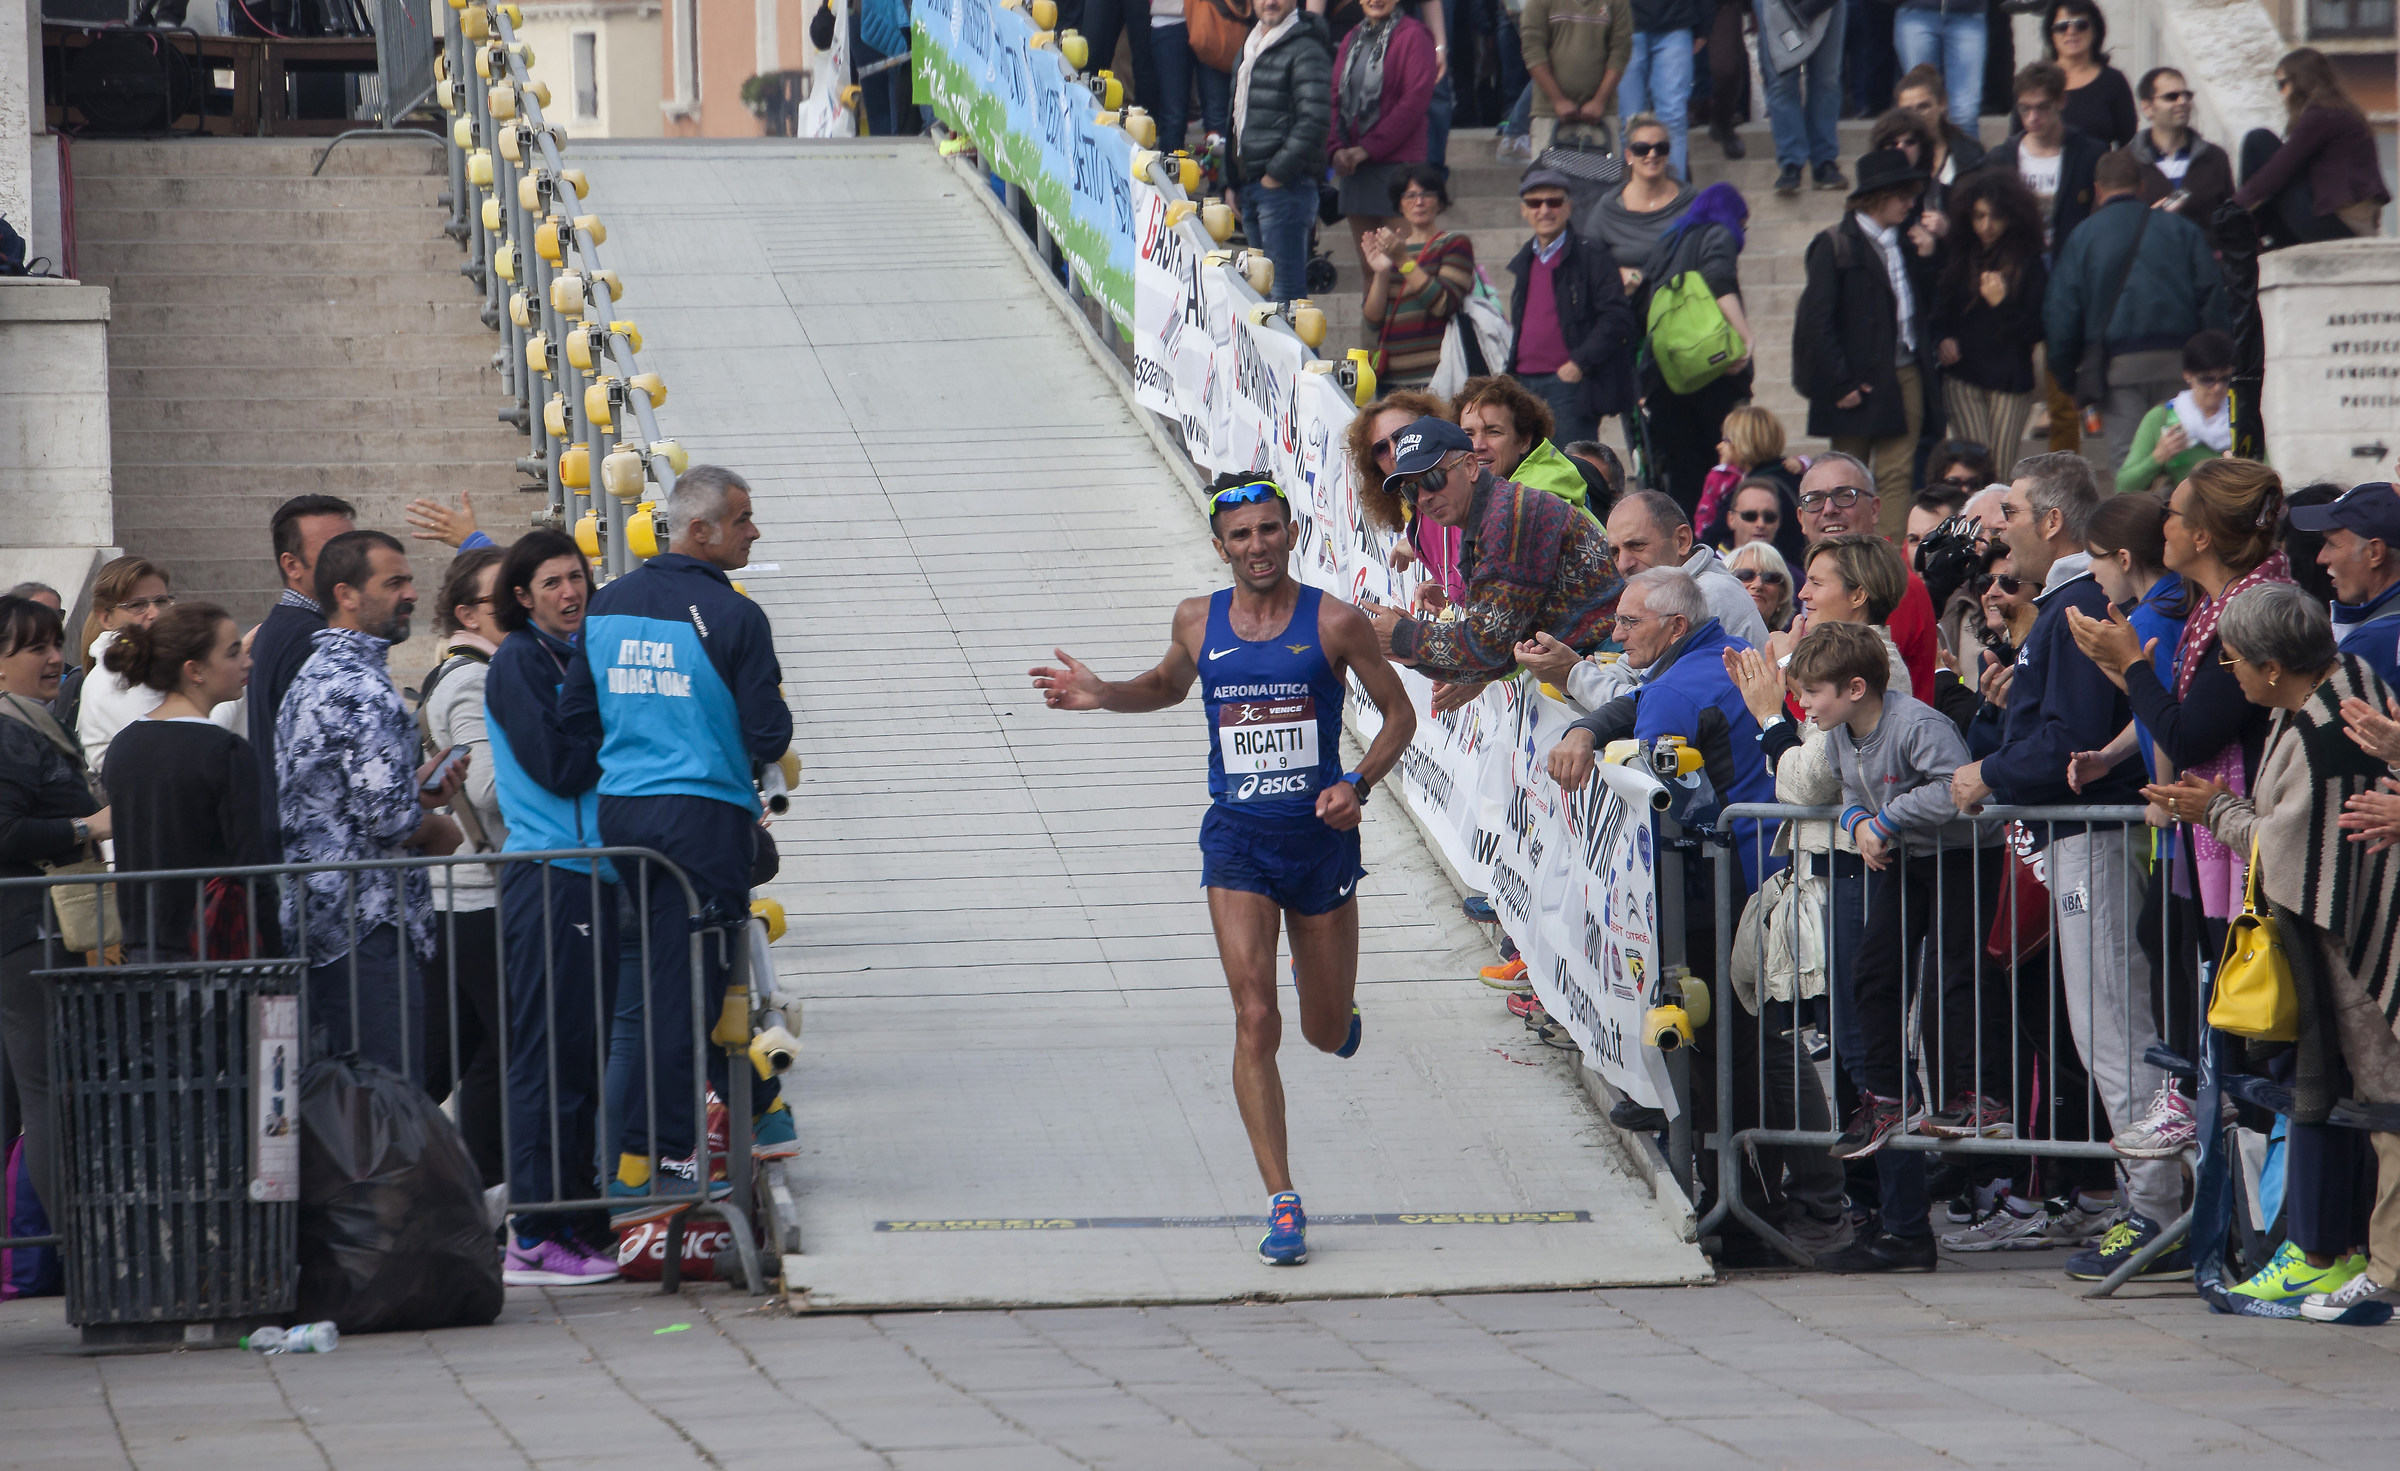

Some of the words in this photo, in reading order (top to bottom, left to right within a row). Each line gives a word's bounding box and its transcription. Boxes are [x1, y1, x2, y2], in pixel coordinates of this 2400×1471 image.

[1213, 683, 1309, 699] AERONAUTICA
[1269, 705, 1303, 714] VENICE
[1233, 727, 1303, 756] RICATTI
[1279, 757, 1288, 769] 9
[1258, 773, 1307, 796] asics
[2061, 893, 2083, 912] NBA
